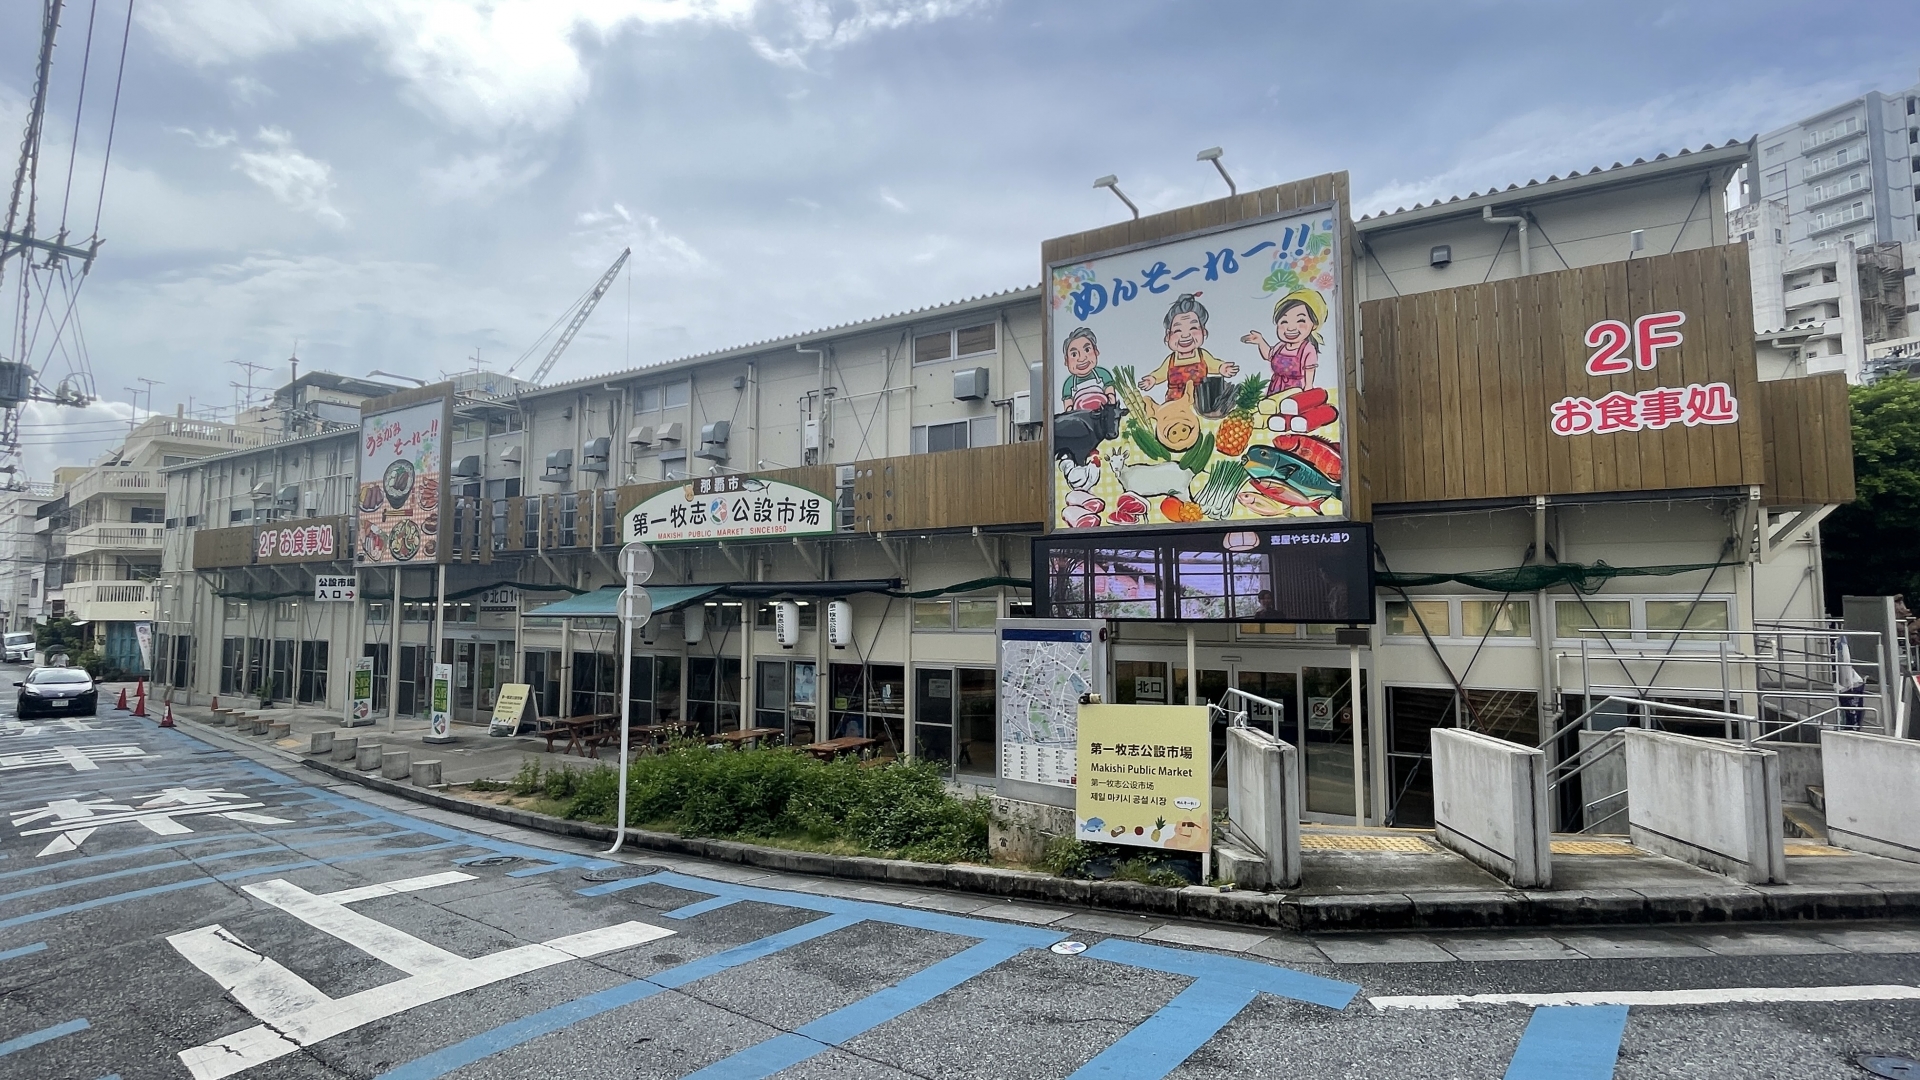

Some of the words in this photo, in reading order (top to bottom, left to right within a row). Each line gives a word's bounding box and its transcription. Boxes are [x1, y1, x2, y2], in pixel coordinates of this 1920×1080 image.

[1586, 312, 1684, 374] 2F
[1553, 384, 1735, 434] お食事処
[700, 475, 739, 494] 那覇市
[633, 500, 707, 537] 第一牧志
[731, 496, 820, 526] 公設市場
[657, 531, 683, 540] MAKISHI
[688, 529, 712, 538] PUBLIC
[717, 527, 744, 536] MARKET
[749, 525, 787, 535] SINCE1950
[260, 531, 277, 556] 2F
[281, 526, 332, 555] お食事処
[318, 578, 356, 587] 公設市場
[318, 590, 341, 599] 入口
[1137, 680, 1162, 693] 北口
[1090, 742, 1193, 760] 第一牧志公設市場
[1090, 762, 1126, 774] Makishi
[1127, 764, 1156, 776] Public
[1158, 766, 1193, 777] Market
[1090, 778, 1154, 791] 第一牧志公设市场
[1090, 792, 1106, 802] 제일
[1107, 793, 1131, 804] 마키시
[1132, 795, 1149, 805] 공설
[1150, 796, 1167, 806] 시장
